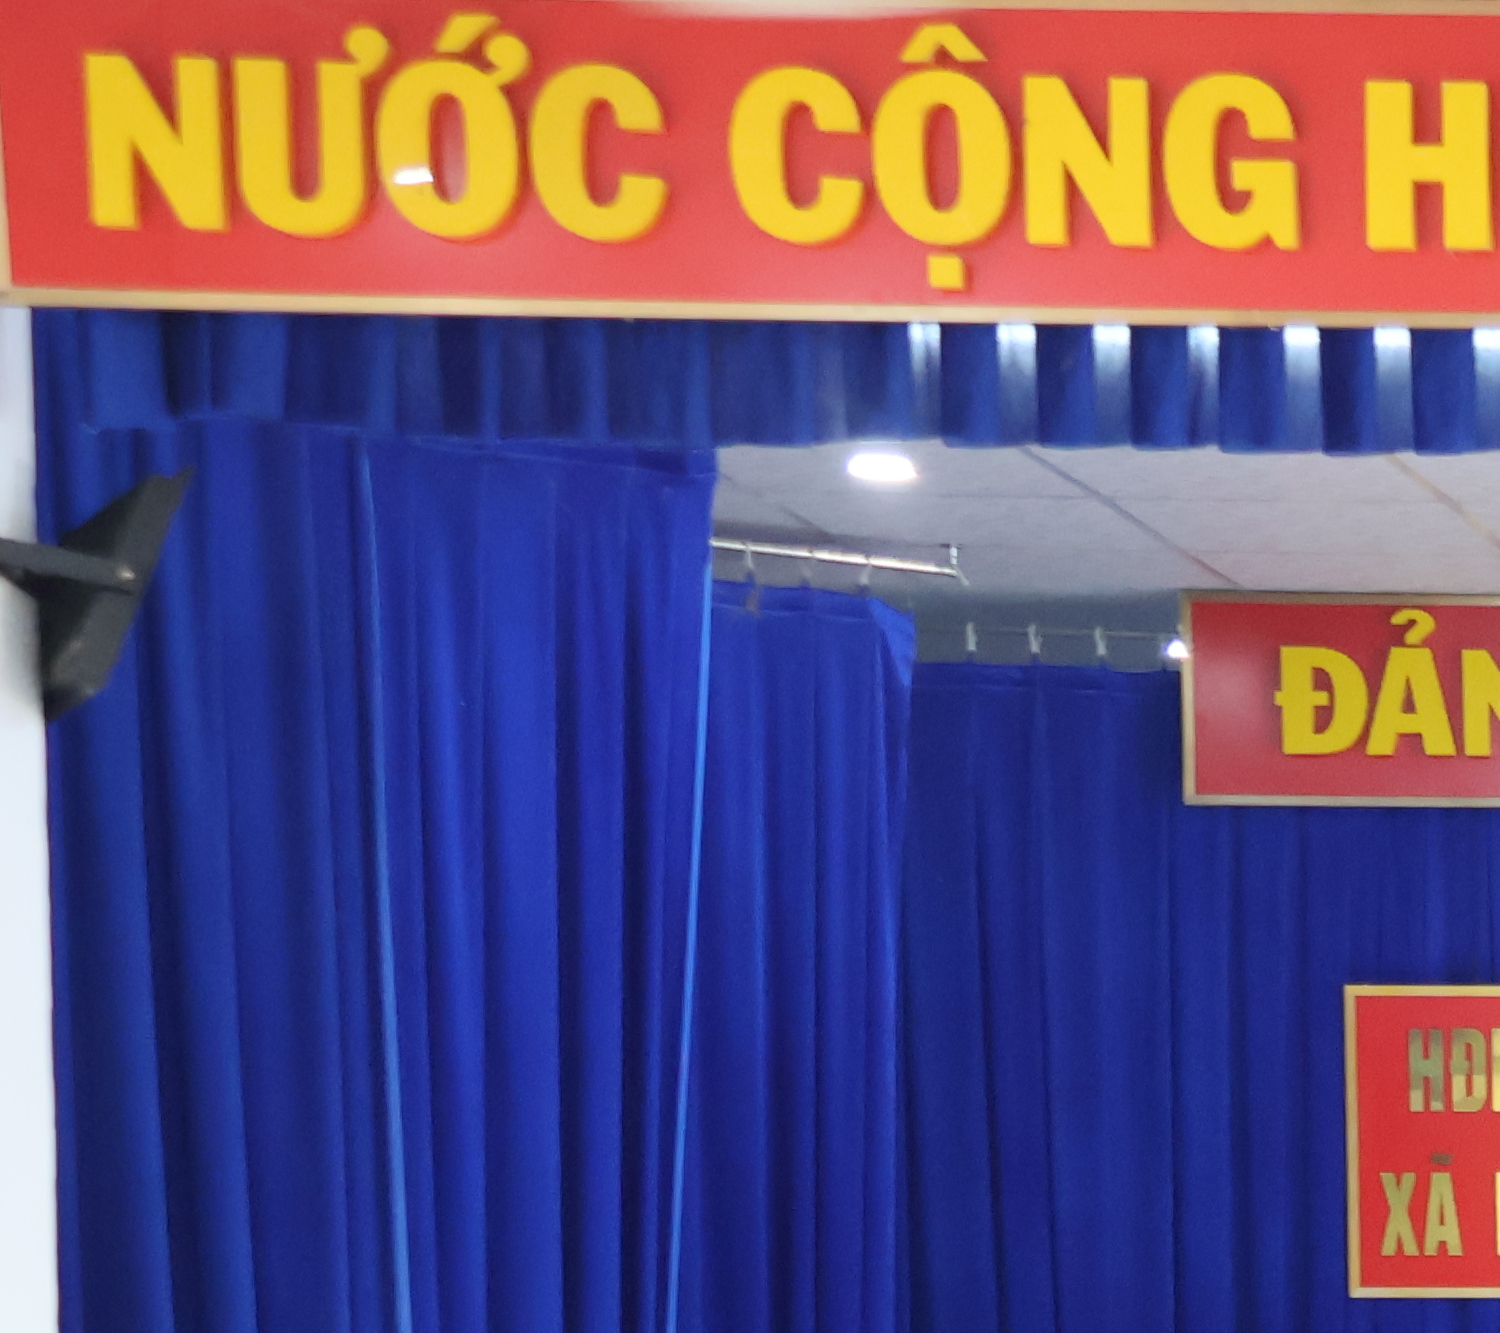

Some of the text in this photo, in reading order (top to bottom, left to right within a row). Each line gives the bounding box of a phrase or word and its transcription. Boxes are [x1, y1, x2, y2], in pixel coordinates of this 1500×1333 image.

[85, 14, 665, 241] NƯỚC
[729, 24, 1298, 288] CỘNG
[1381, 1151, 1463, 1256] XÃ
